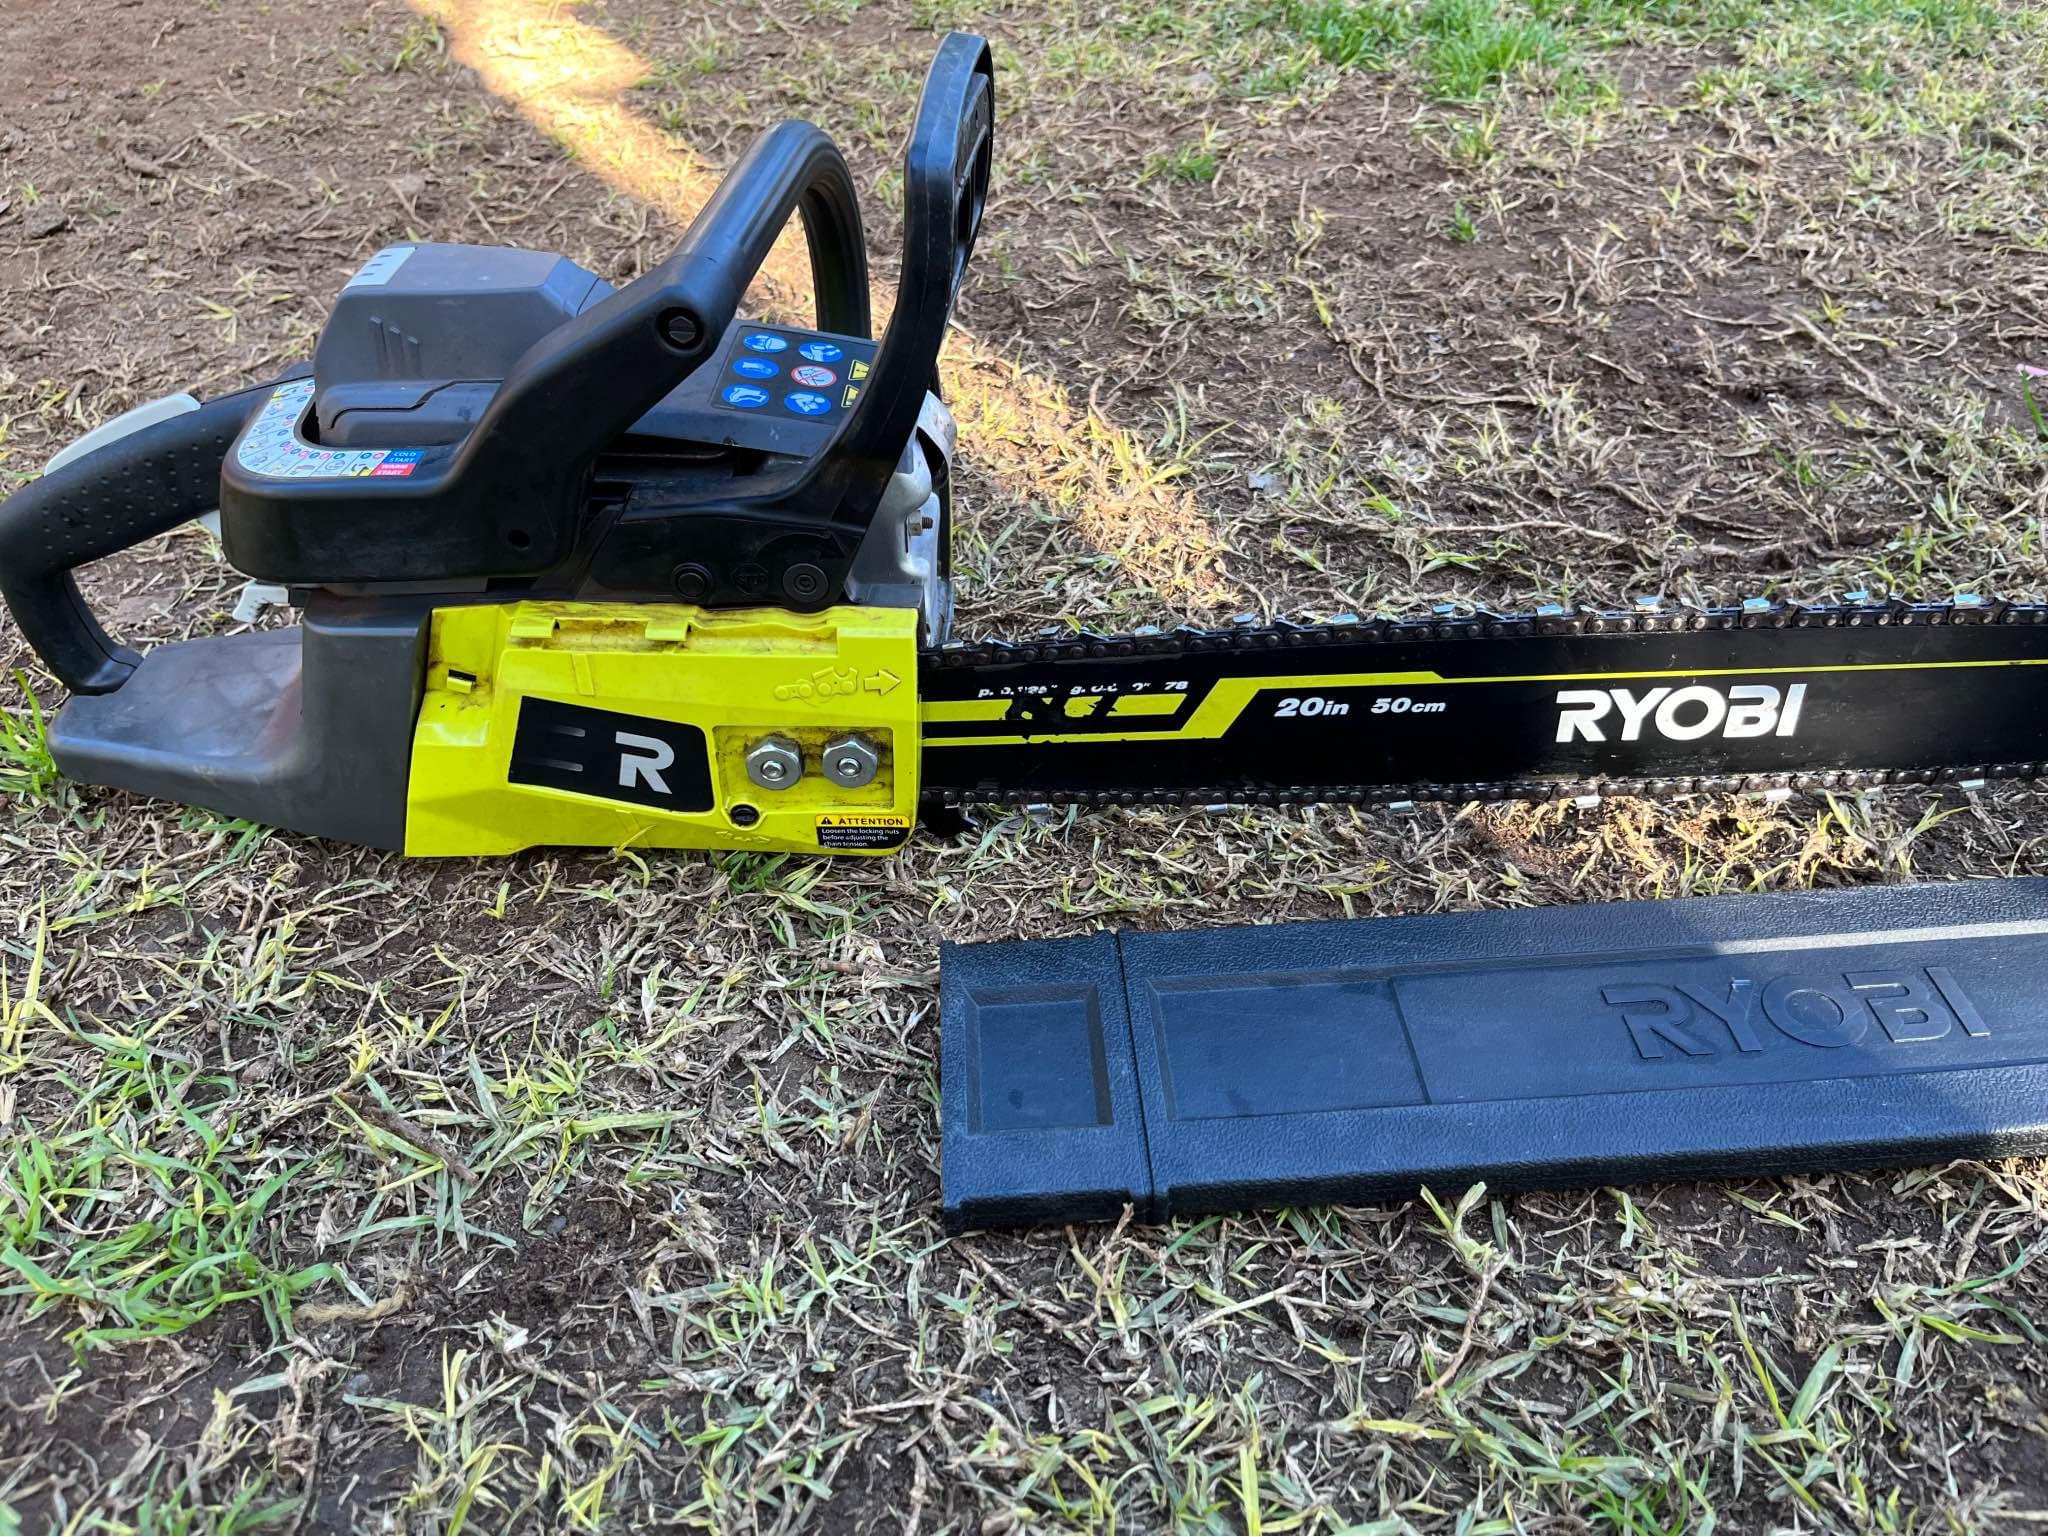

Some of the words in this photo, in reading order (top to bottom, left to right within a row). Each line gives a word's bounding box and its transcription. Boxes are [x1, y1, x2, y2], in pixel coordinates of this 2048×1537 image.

[1273, 697, 1350, 718] 20in
[1370, 696, 1447, 714] 50cm
[1555, 683, 1808, 743] RYOBI
[614, 730, 676, 795] R
[838, 817, 903, 826] ATTENTION
[859, 828, 884, 836] locking
[1601, 966, 1991, 1060] RYOBI
